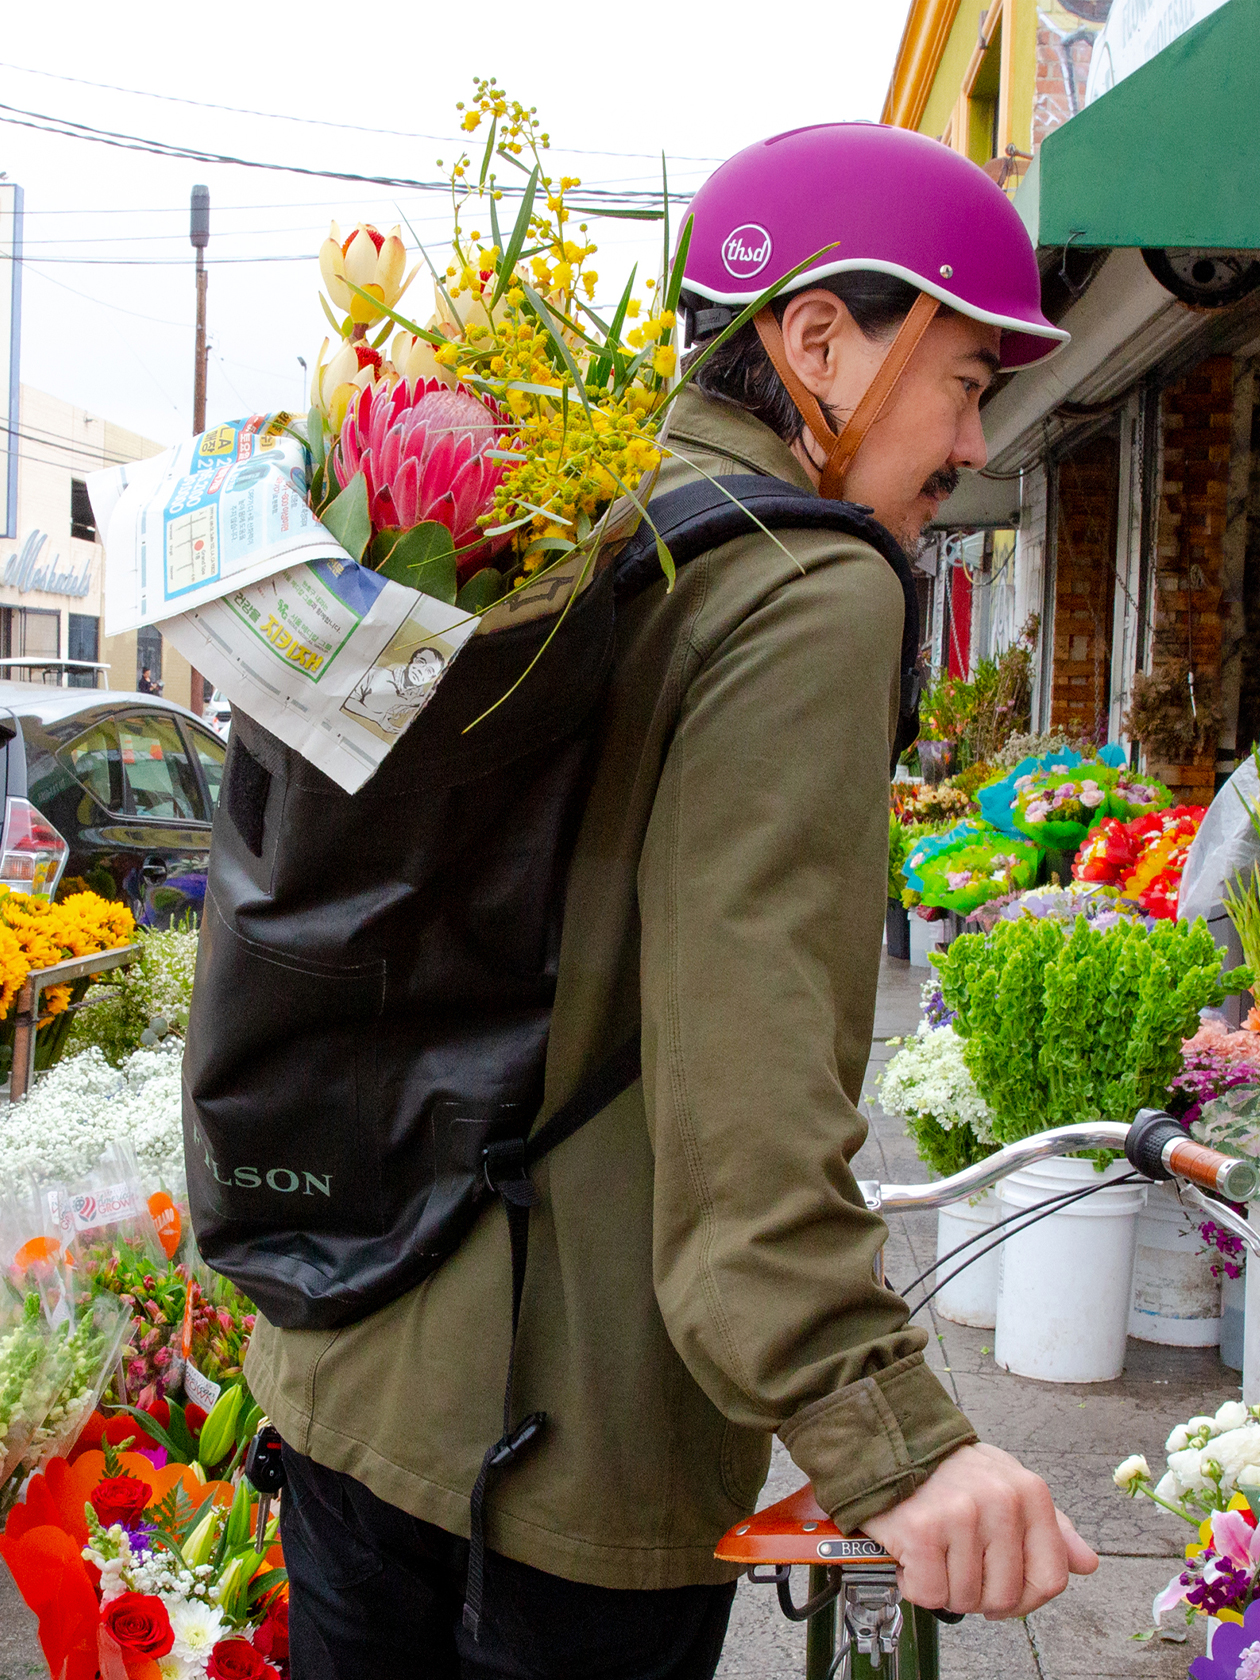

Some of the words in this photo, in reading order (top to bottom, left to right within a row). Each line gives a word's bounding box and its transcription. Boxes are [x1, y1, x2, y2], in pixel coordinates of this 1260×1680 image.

[727, 238, 768, 262] thsd
[218, 427, 231, 449] LA
[234, 592, 261, 624] 건강을
[260, 613, 324, 672] 지키자!
